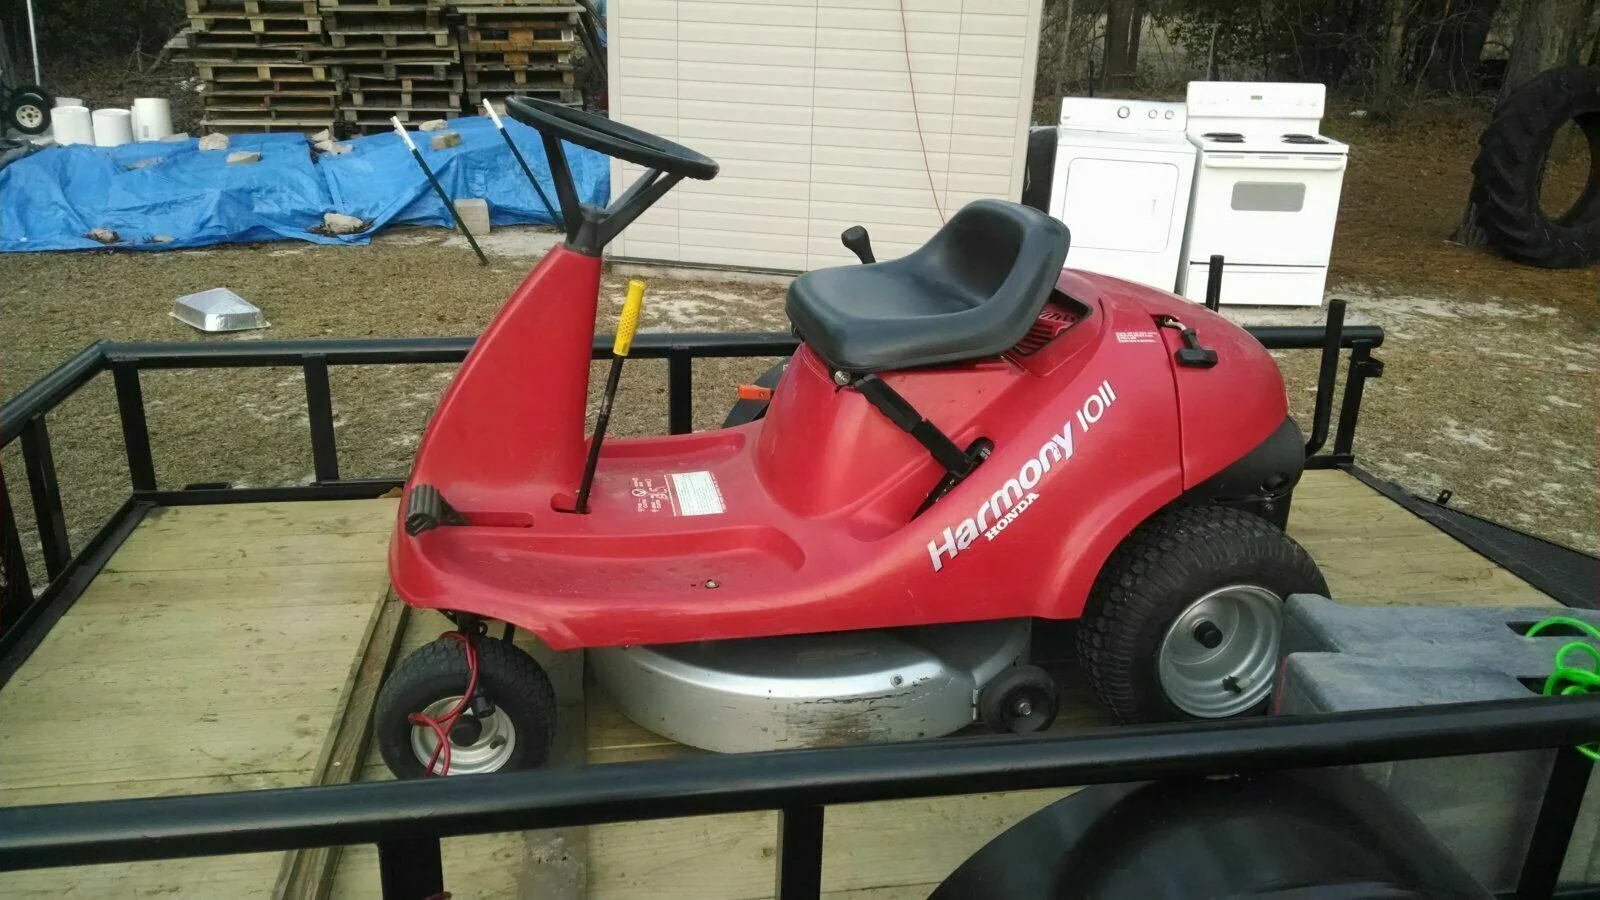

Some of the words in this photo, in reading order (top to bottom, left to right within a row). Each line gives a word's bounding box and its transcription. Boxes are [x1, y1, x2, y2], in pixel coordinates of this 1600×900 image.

[927, 420, 1074, 573] Harmony
[1076, 379, 1117, 433] 1011
[984, 491, 1040, 542] HONDA
